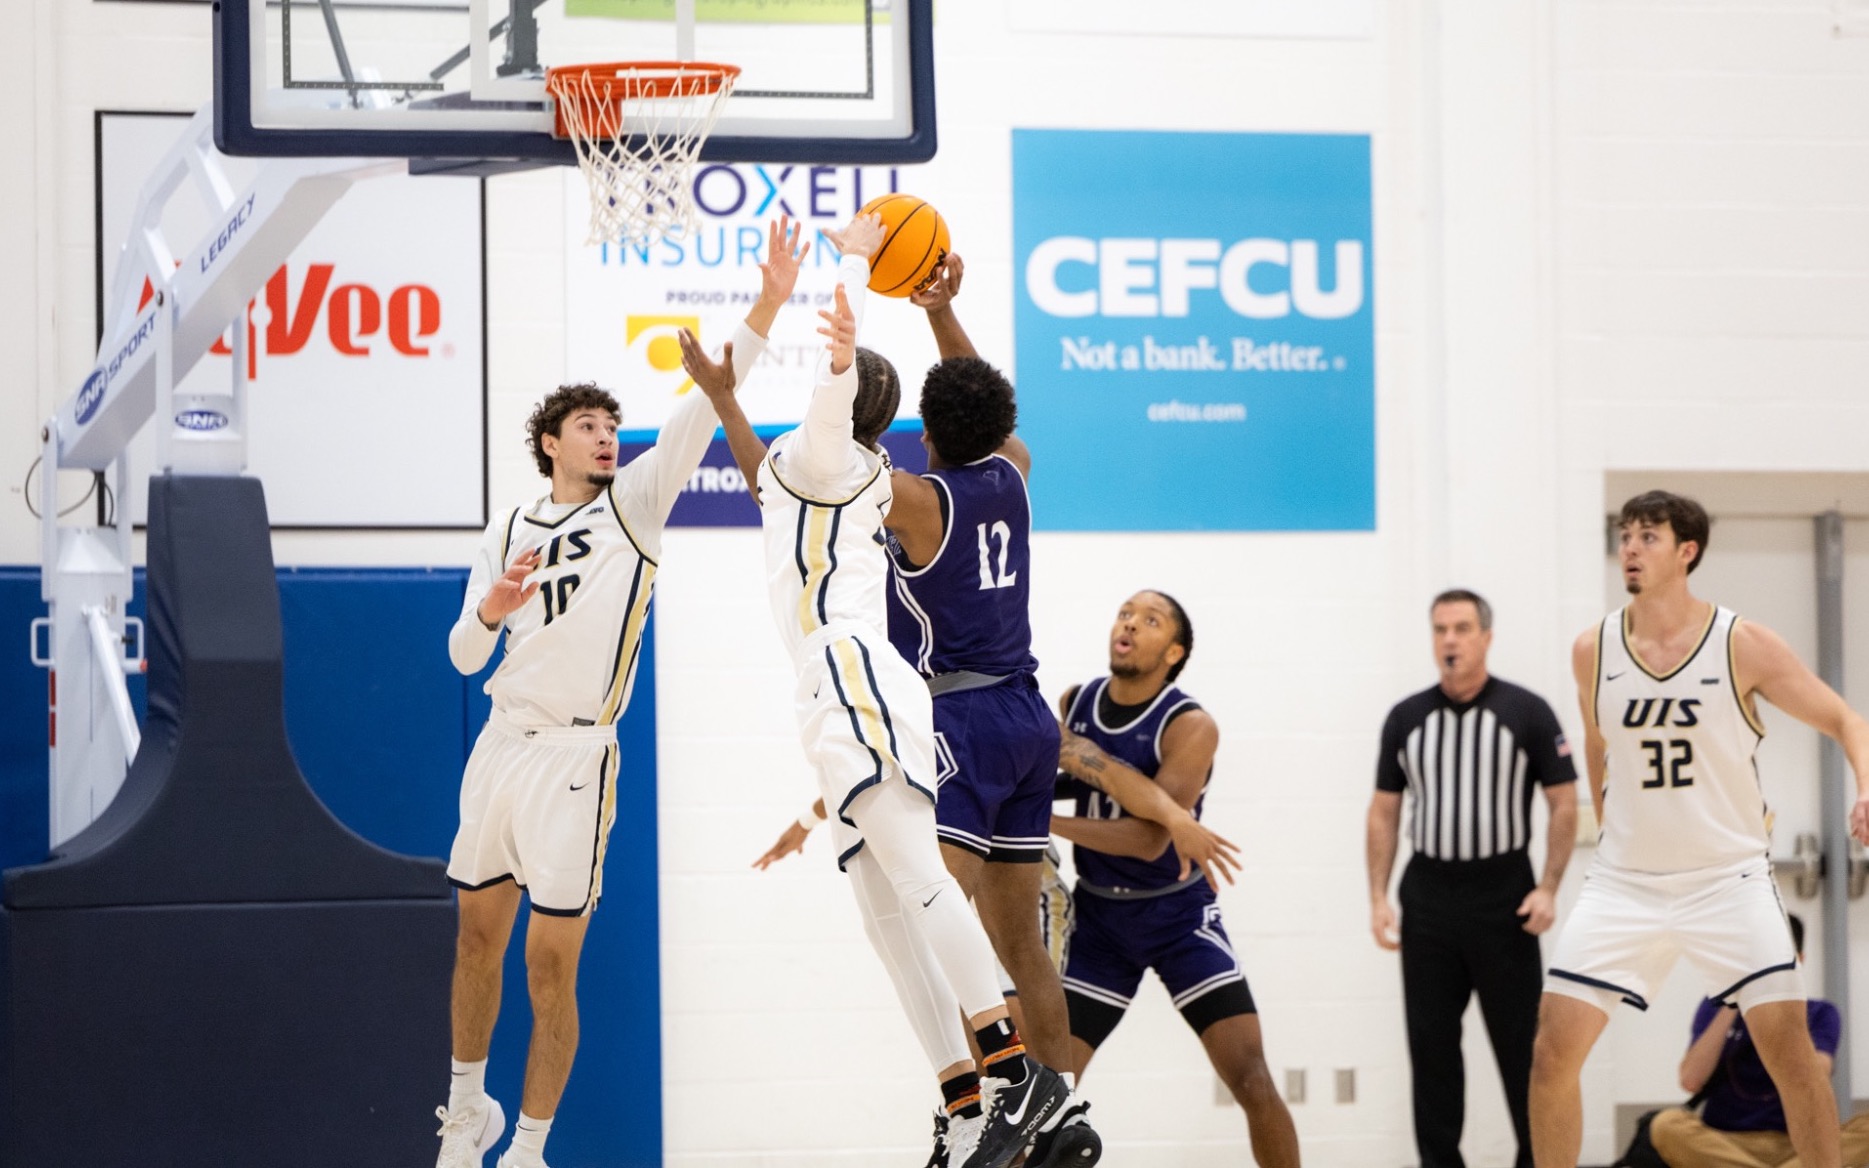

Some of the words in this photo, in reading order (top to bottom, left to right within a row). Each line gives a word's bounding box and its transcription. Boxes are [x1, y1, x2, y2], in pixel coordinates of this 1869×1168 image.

[200, 192, 256, 274] LEGACY
[1025, 235, 1364, 320] CEFCU
[1060, 336, 1118, 371] Not
[1120, 344, 1140, 371] a
[1142, 335, 1227, 371] bank.
[1231, 337, 1328, 371] Better.
[1147, 400, 1246, 422] cefcu.com
[977, 520, 1017, 591] 12
[540, 573, 581, 626] 10
[1622, 697, 1702, 728] UIS
[1641, 739, 1694, 789] 32
